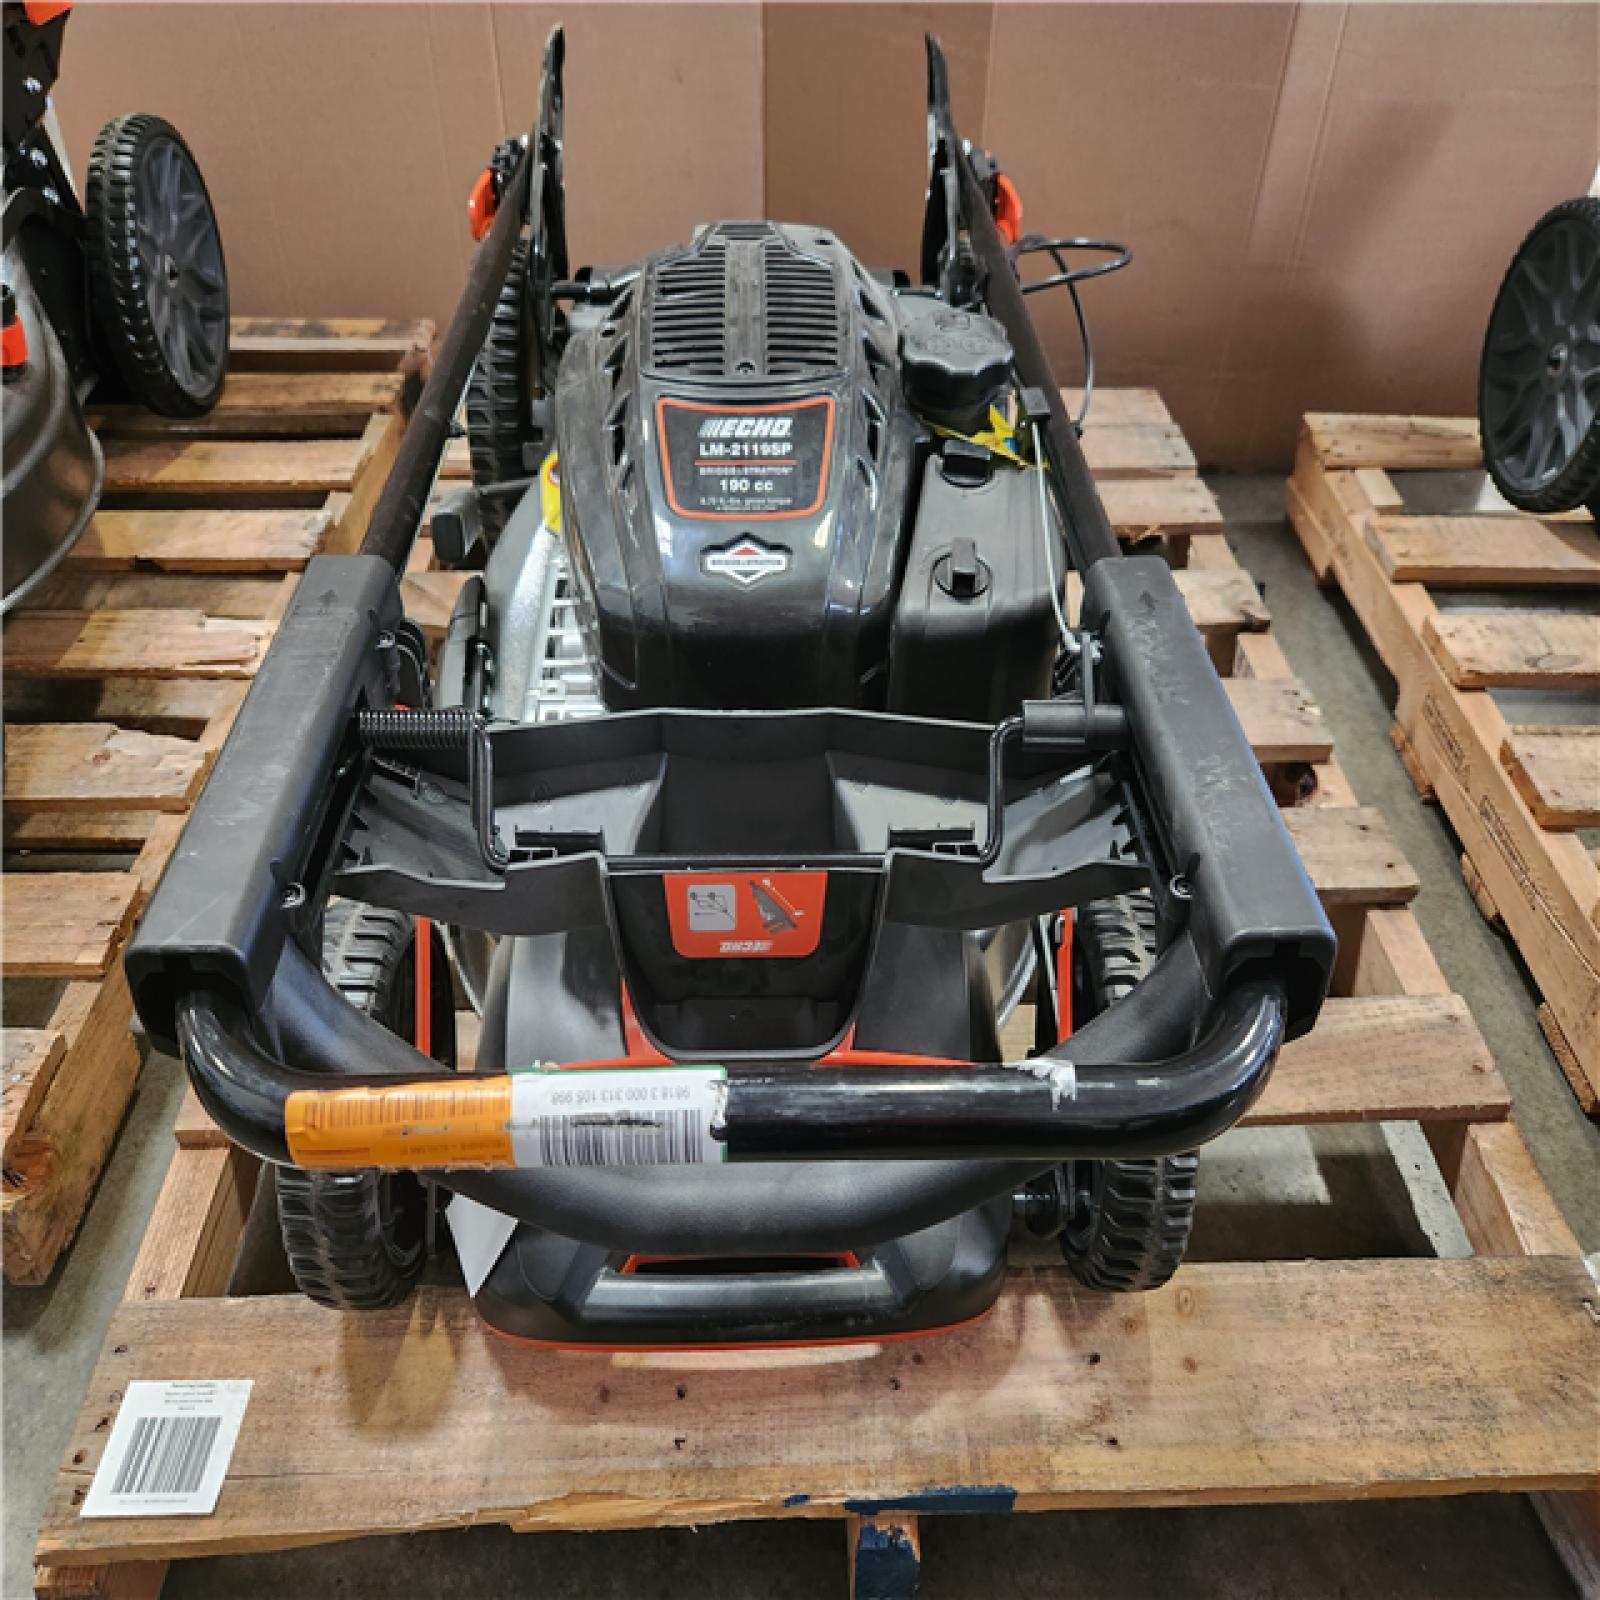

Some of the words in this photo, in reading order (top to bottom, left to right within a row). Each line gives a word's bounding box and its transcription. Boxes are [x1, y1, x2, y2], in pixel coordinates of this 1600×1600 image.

[709, 418, 793, 437] ECHO
[699, 442, 793, 456] LM-2119SP
[719, 479, 751, 492] 190
[754, 480, 774, 491] cc
